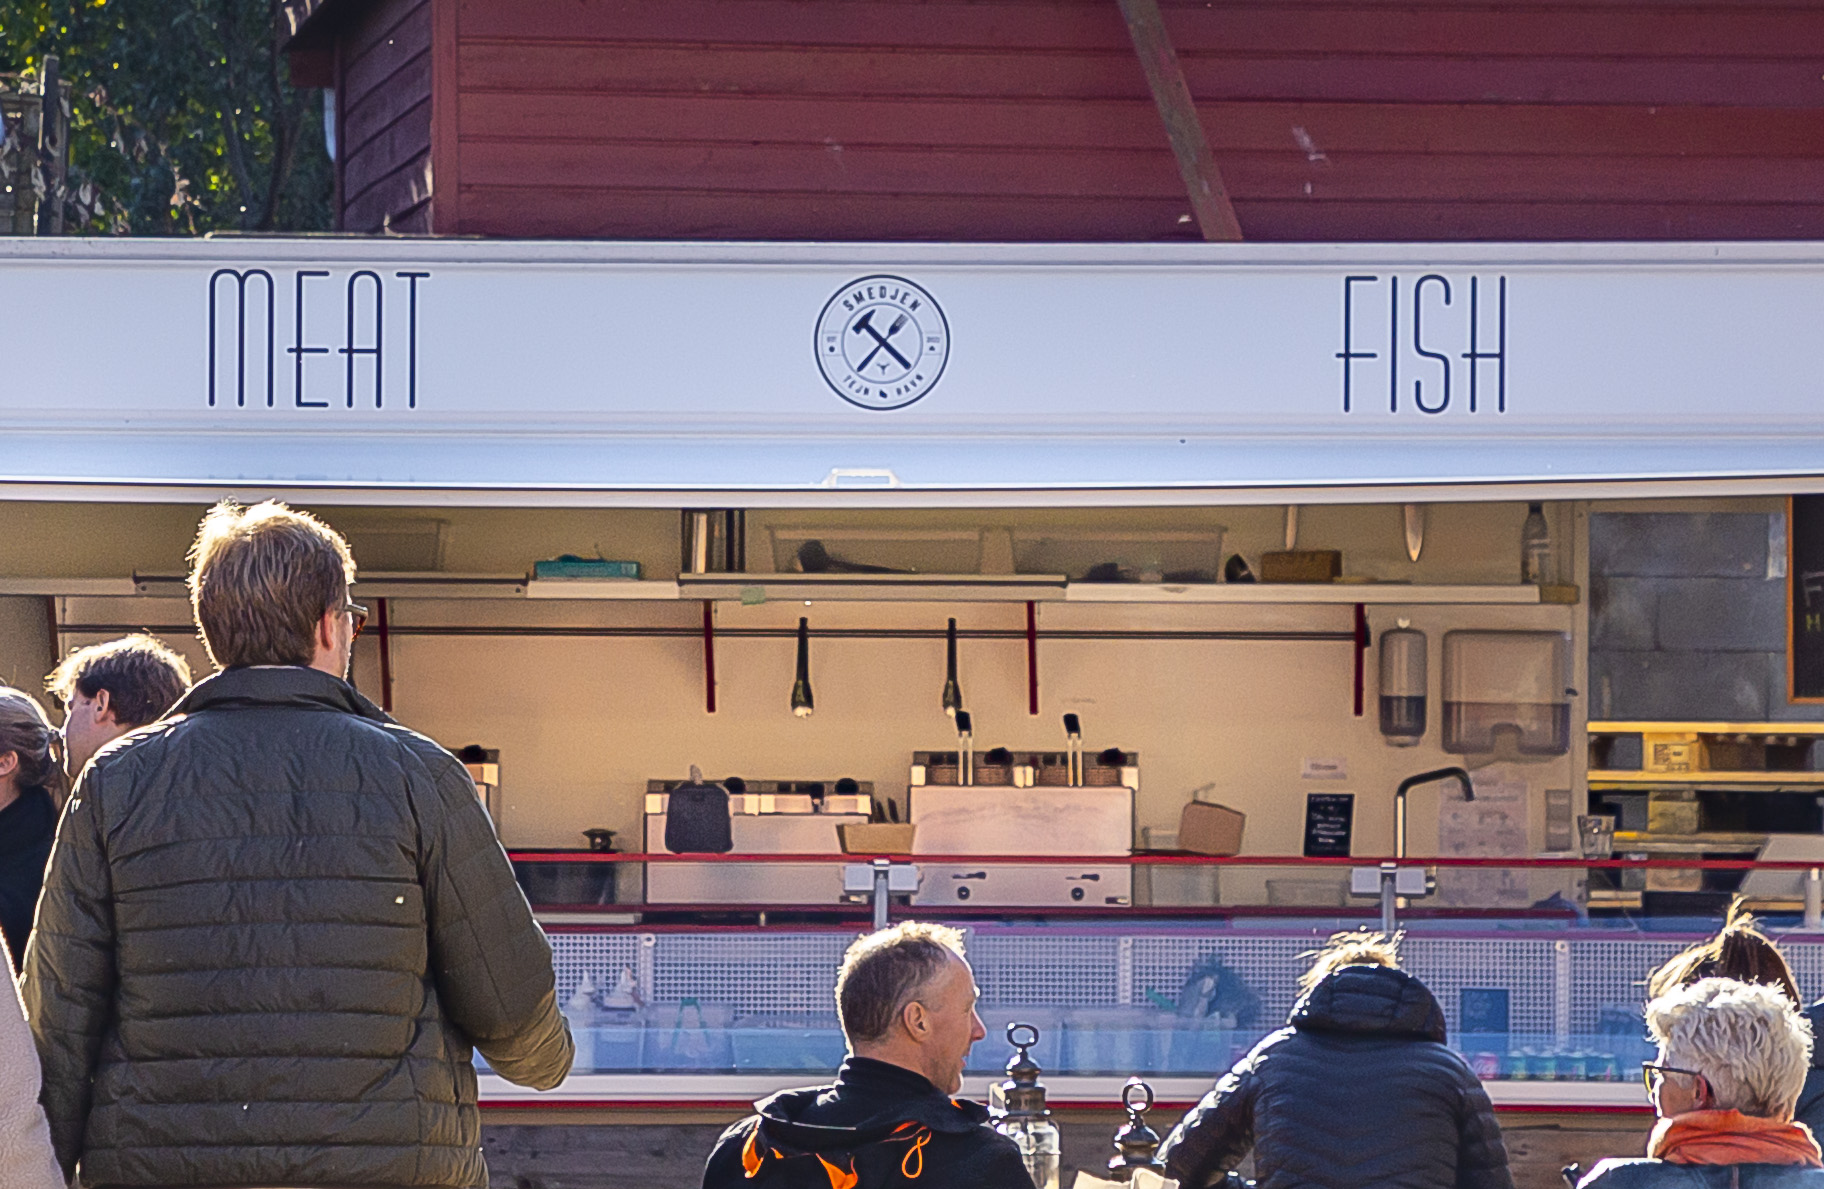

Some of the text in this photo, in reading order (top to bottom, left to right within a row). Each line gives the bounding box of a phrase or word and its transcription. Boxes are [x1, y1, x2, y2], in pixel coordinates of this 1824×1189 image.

[208, 268, 430, 408] MEAT
[842, 285, 922, 312] SMEDJEN
[1335, 274, 1506, 414] FISH
